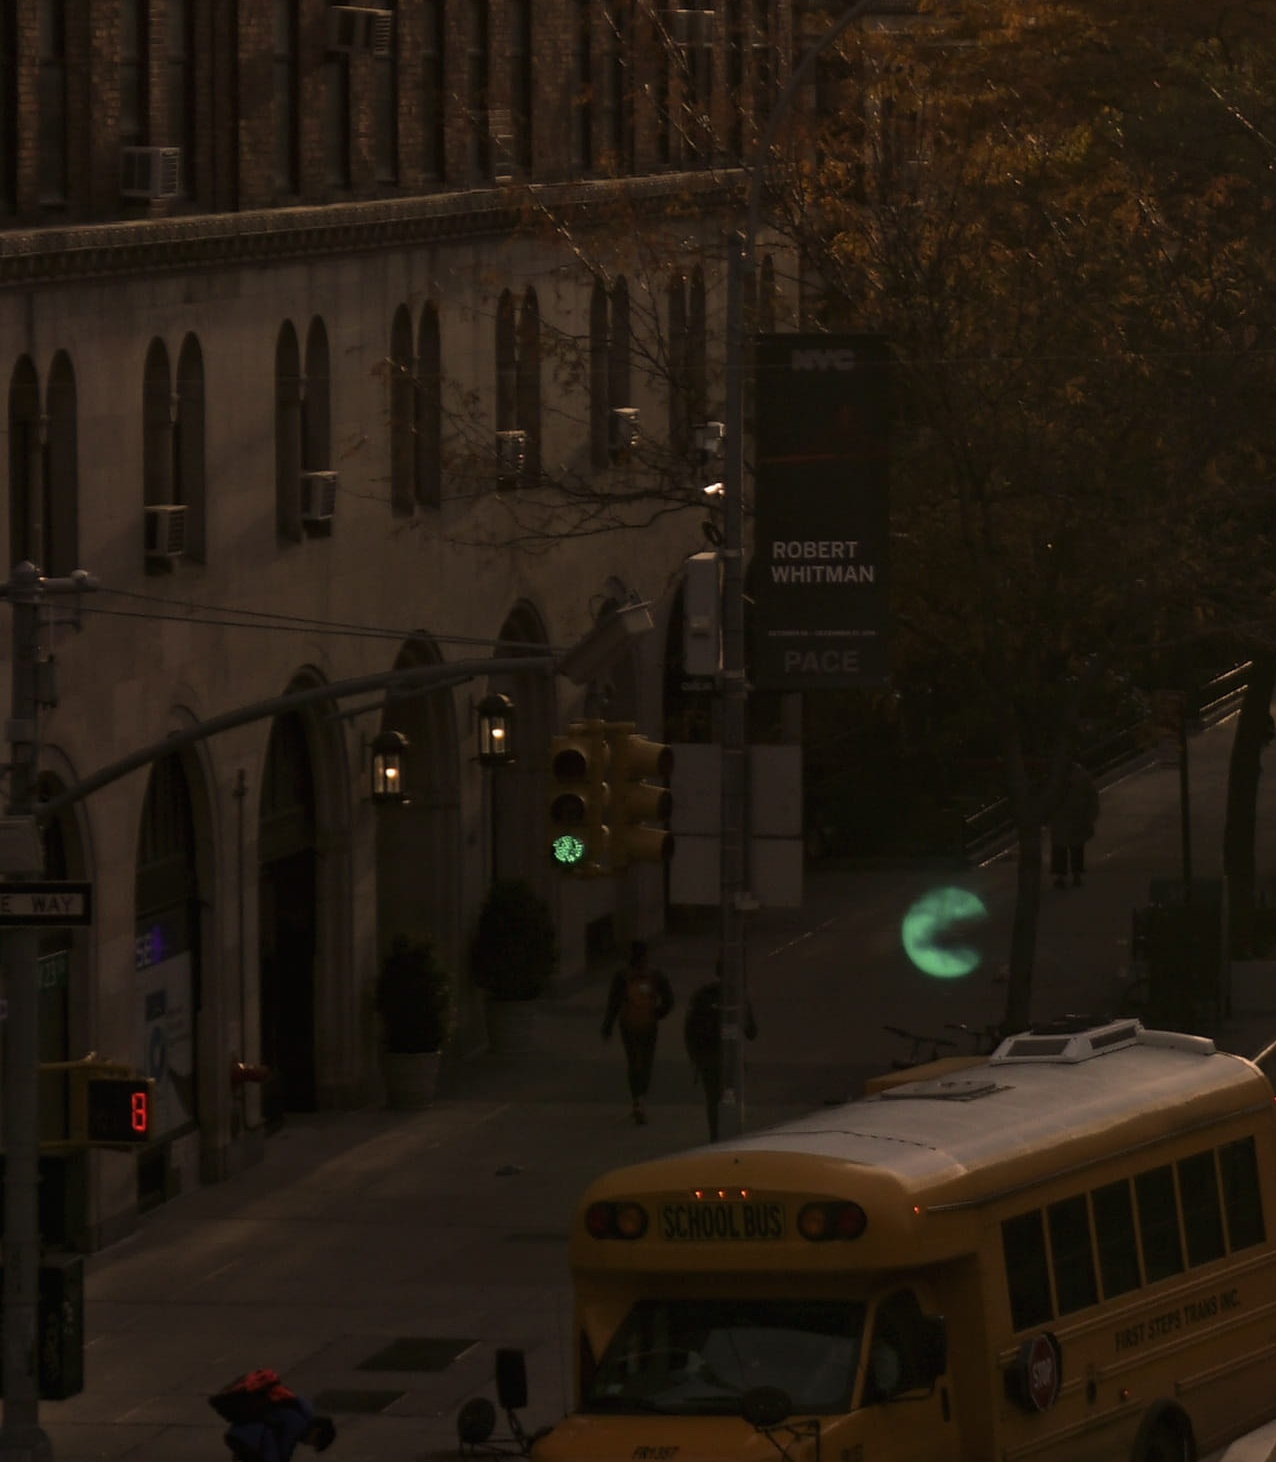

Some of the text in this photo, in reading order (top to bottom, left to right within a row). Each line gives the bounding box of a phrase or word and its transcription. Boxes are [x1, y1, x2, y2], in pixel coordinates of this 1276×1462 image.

[791, 348, 856, 372] NYC
[772, 540, 859, 559] ROBERT
[771, 564, 875, 584] WHITMAN
[784, 650, 862, 673] PACE
[32, 896, 73, 913] WAY
[662, 1203, 782, 1238] SCHOOL BUS
[1115, 1323, 1146, 1352] FIRST
[1148, 1309, 1181, 1341] STEPS
[1032, 1356, 1052, 1389] STOP
